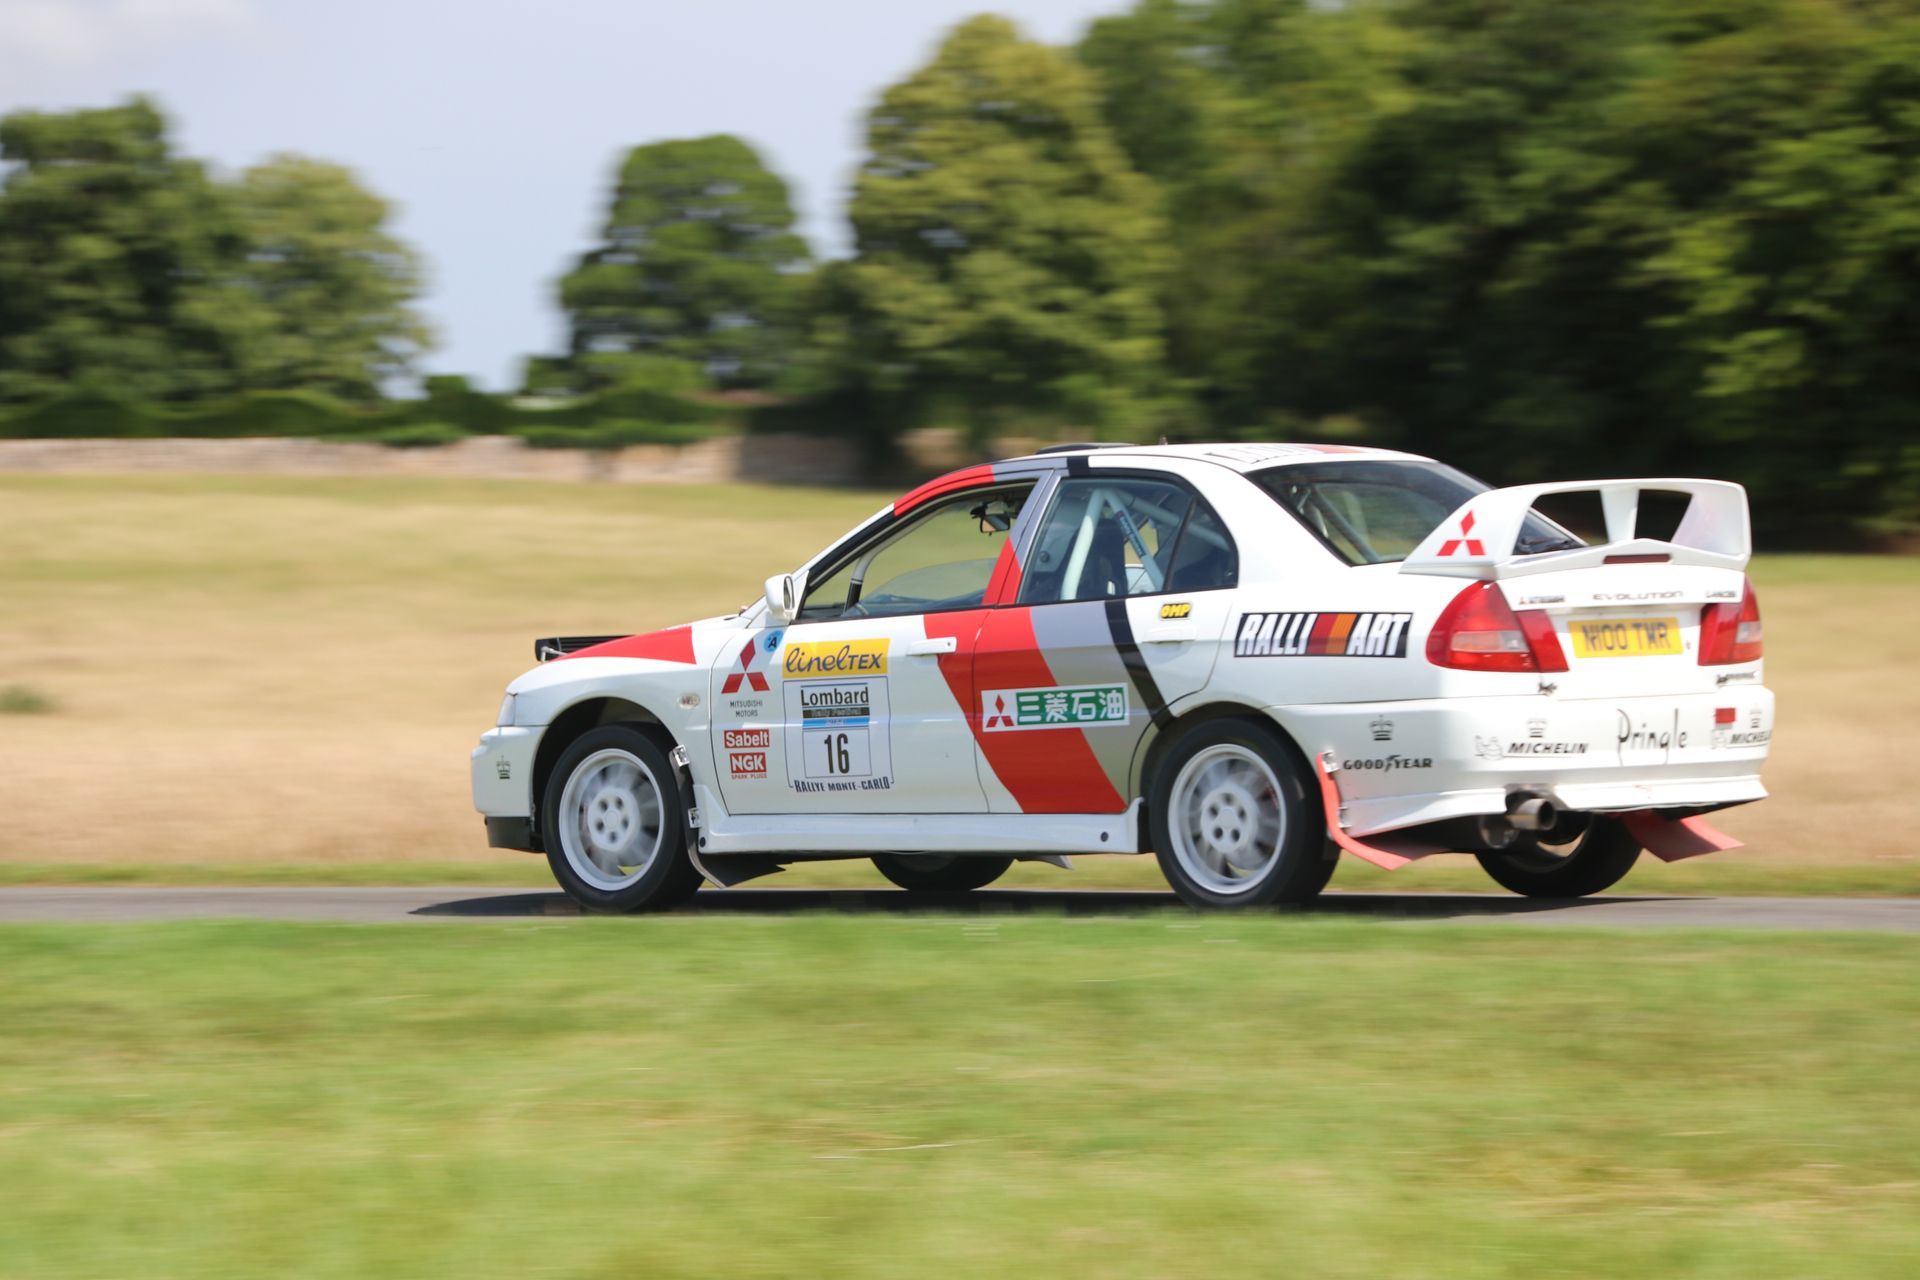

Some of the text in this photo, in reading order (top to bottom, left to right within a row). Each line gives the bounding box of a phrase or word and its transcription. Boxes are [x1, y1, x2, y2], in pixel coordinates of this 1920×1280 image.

[1592, 590, 1684, 602] EVOLUTION
[1160, 603, 1191, 619] OMP
[768, 636, 778, 648] A
[1236, 613, 1412, 656] RALLI ART
[730, 699, 763, 709] MITSUBISHI
[800, 686, 869, 706] Lombard
[735, 709, 758, 718] MOTORS
[1018, 688, 1126, 725] 三菱石油
[725, 730, 769, 747] Sabelt
[1616, 707, 1688, 766] Pringle
[824, 733, 850, 774] 16
[1508, 741, 1590, 755] MICHELIN
[731, 754, 765, 772] NGK
[1343, 755, 1432, 770] GOODYEAR
[794, 779, 825, 793] RALLYE
